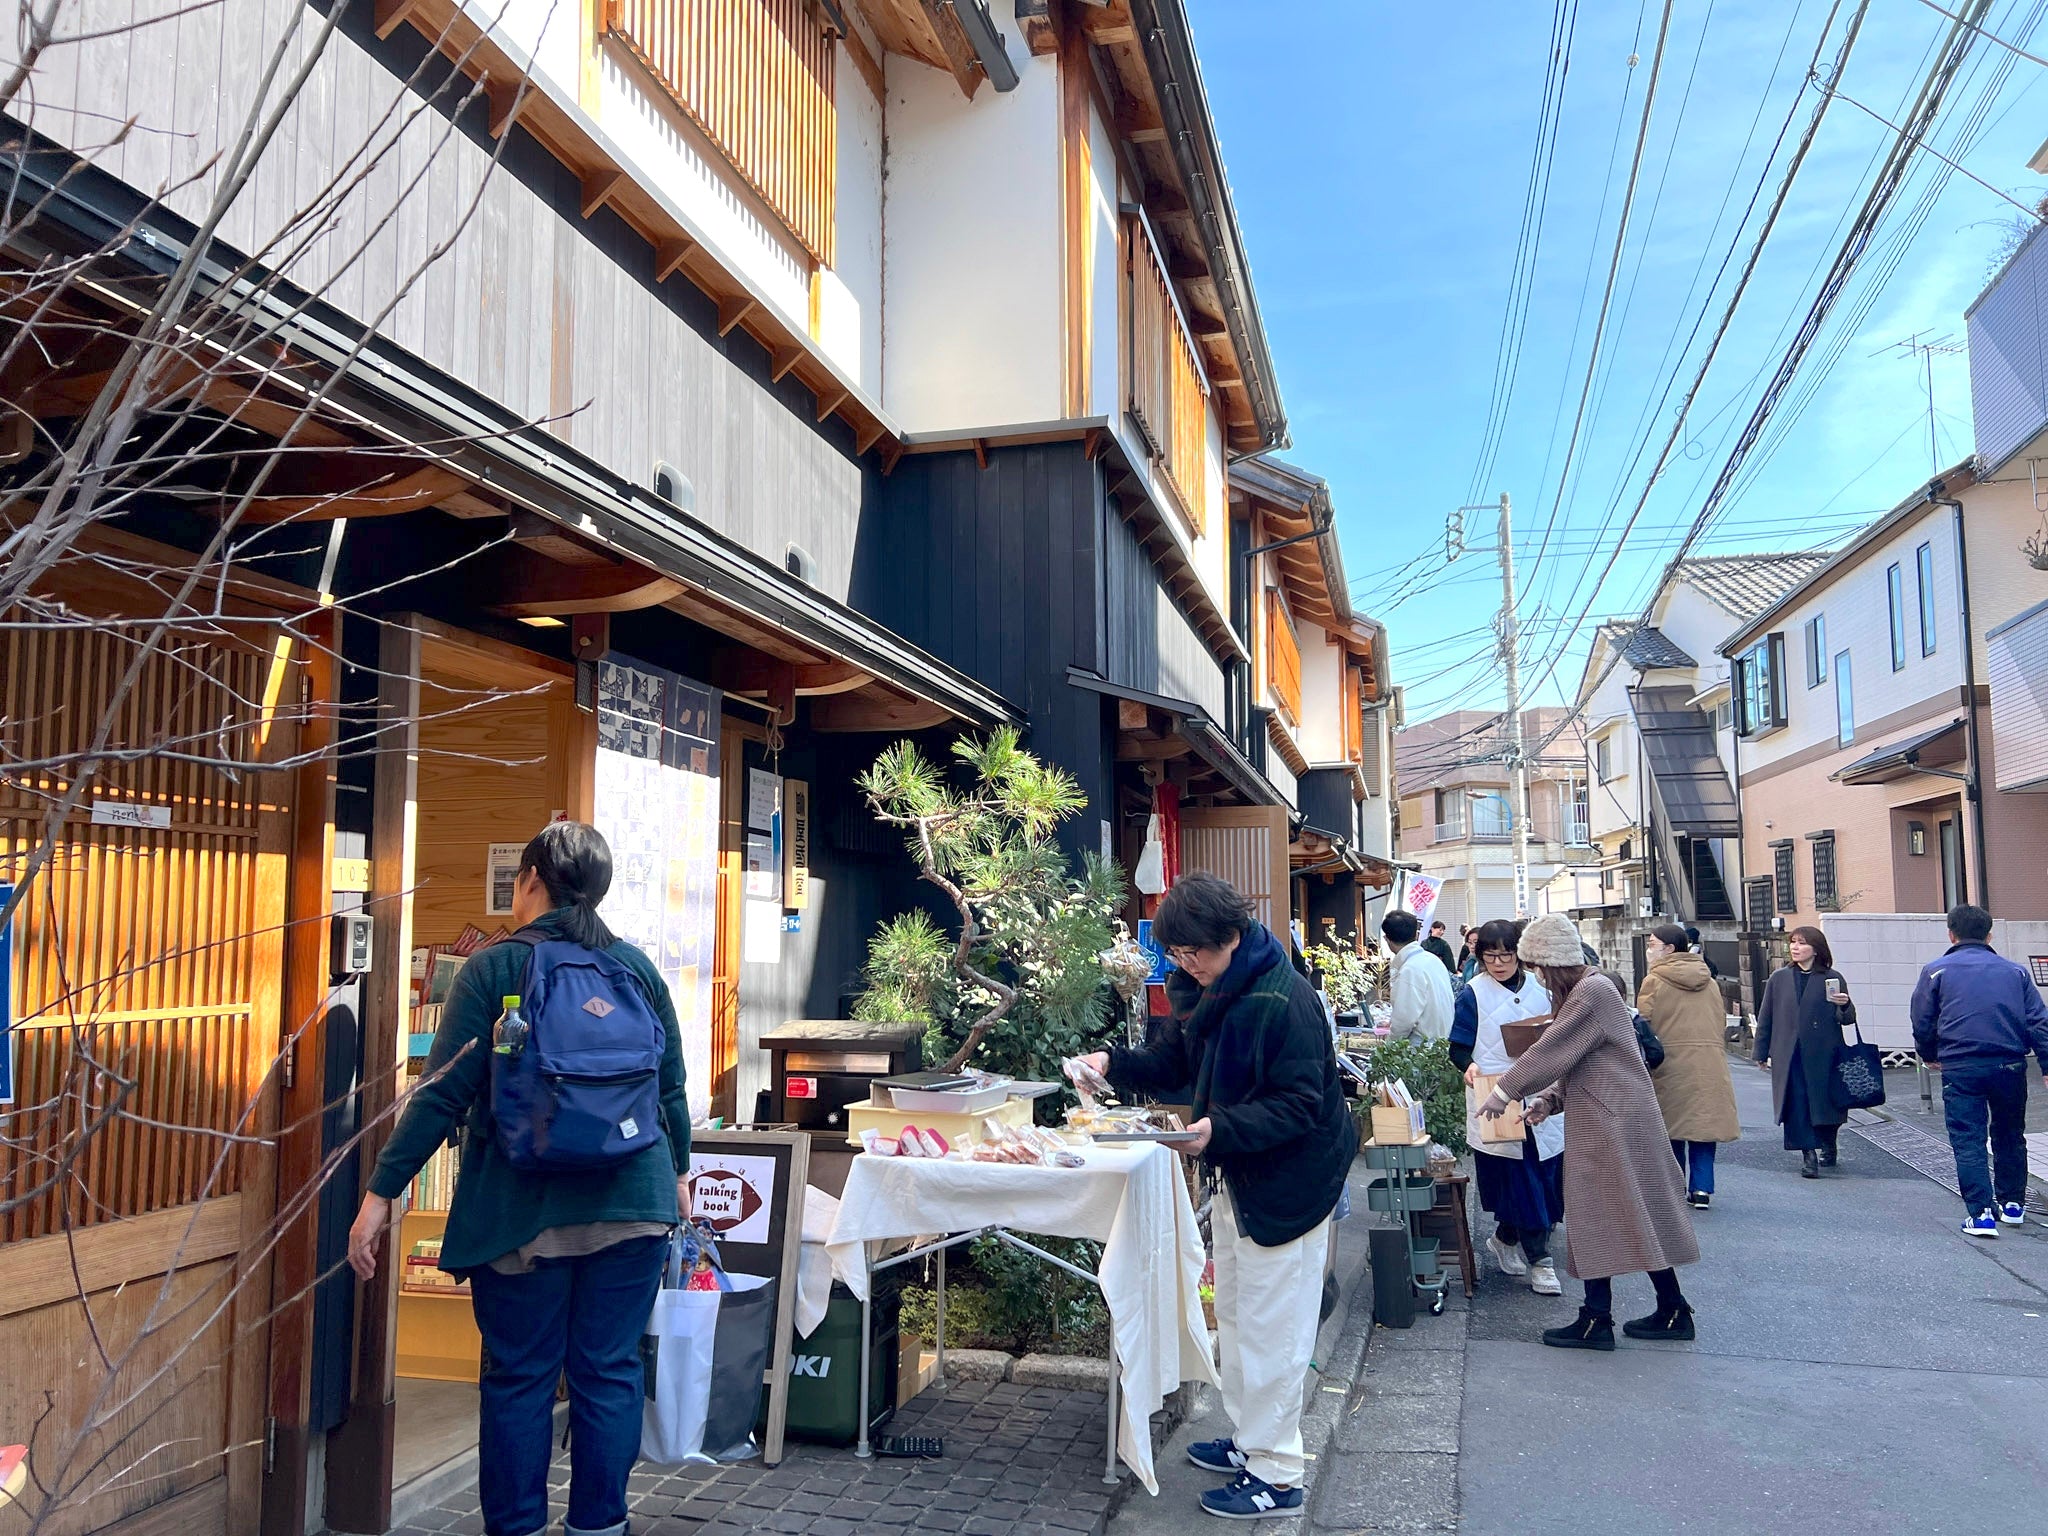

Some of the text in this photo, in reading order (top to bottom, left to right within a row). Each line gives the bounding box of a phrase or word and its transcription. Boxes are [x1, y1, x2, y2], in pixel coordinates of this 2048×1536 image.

[699, 1183, 738, 1201] talking
[703, 1201, 730, 1212] book
[1227, 1451, 1247, 1468] N
[1251, 1490, 1277, 1512] N
